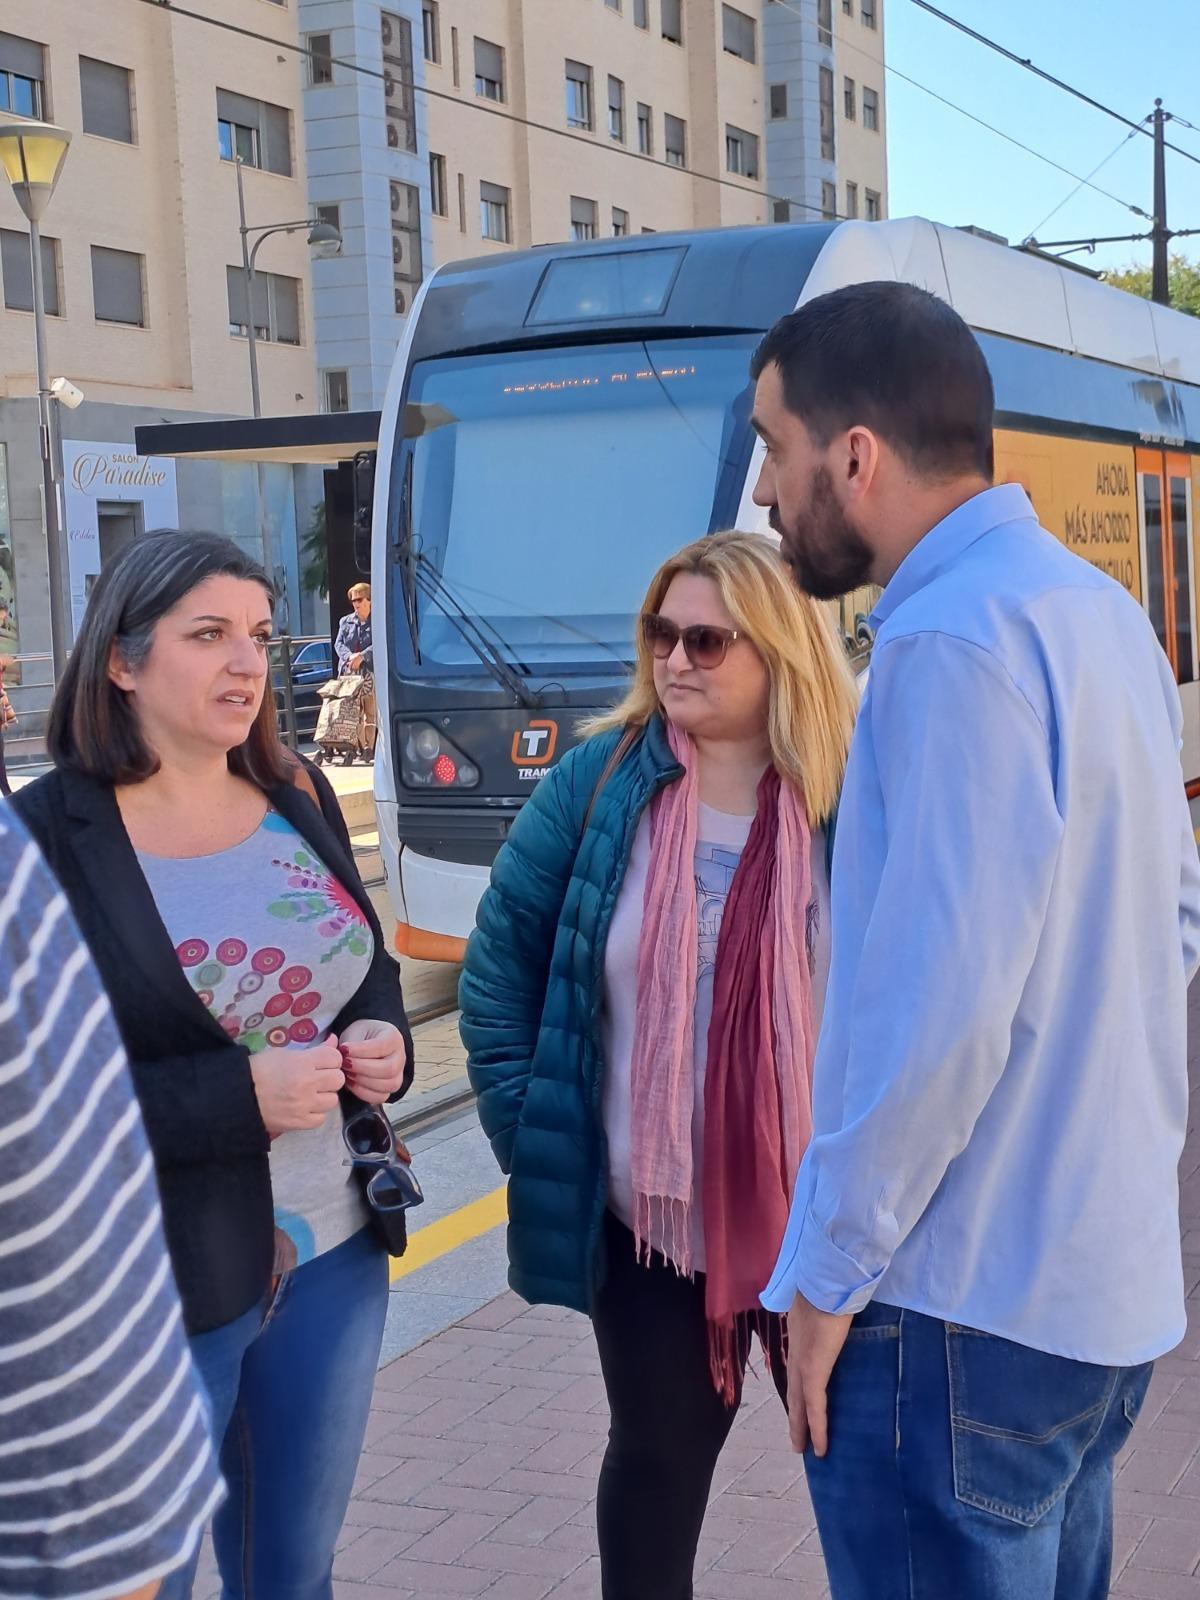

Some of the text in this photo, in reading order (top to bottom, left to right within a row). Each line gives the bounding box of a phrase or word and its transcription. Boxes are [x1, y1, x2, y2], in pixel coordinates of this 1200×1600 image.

[72, 452, 166, 496] Paradise
[112, 454, 139, 464] SALON
[1096, 463, 1130, 497] AHORA
[1065, 501, 1132, 545] MÁS AHORRO
[522, 730, 548, 756] T
